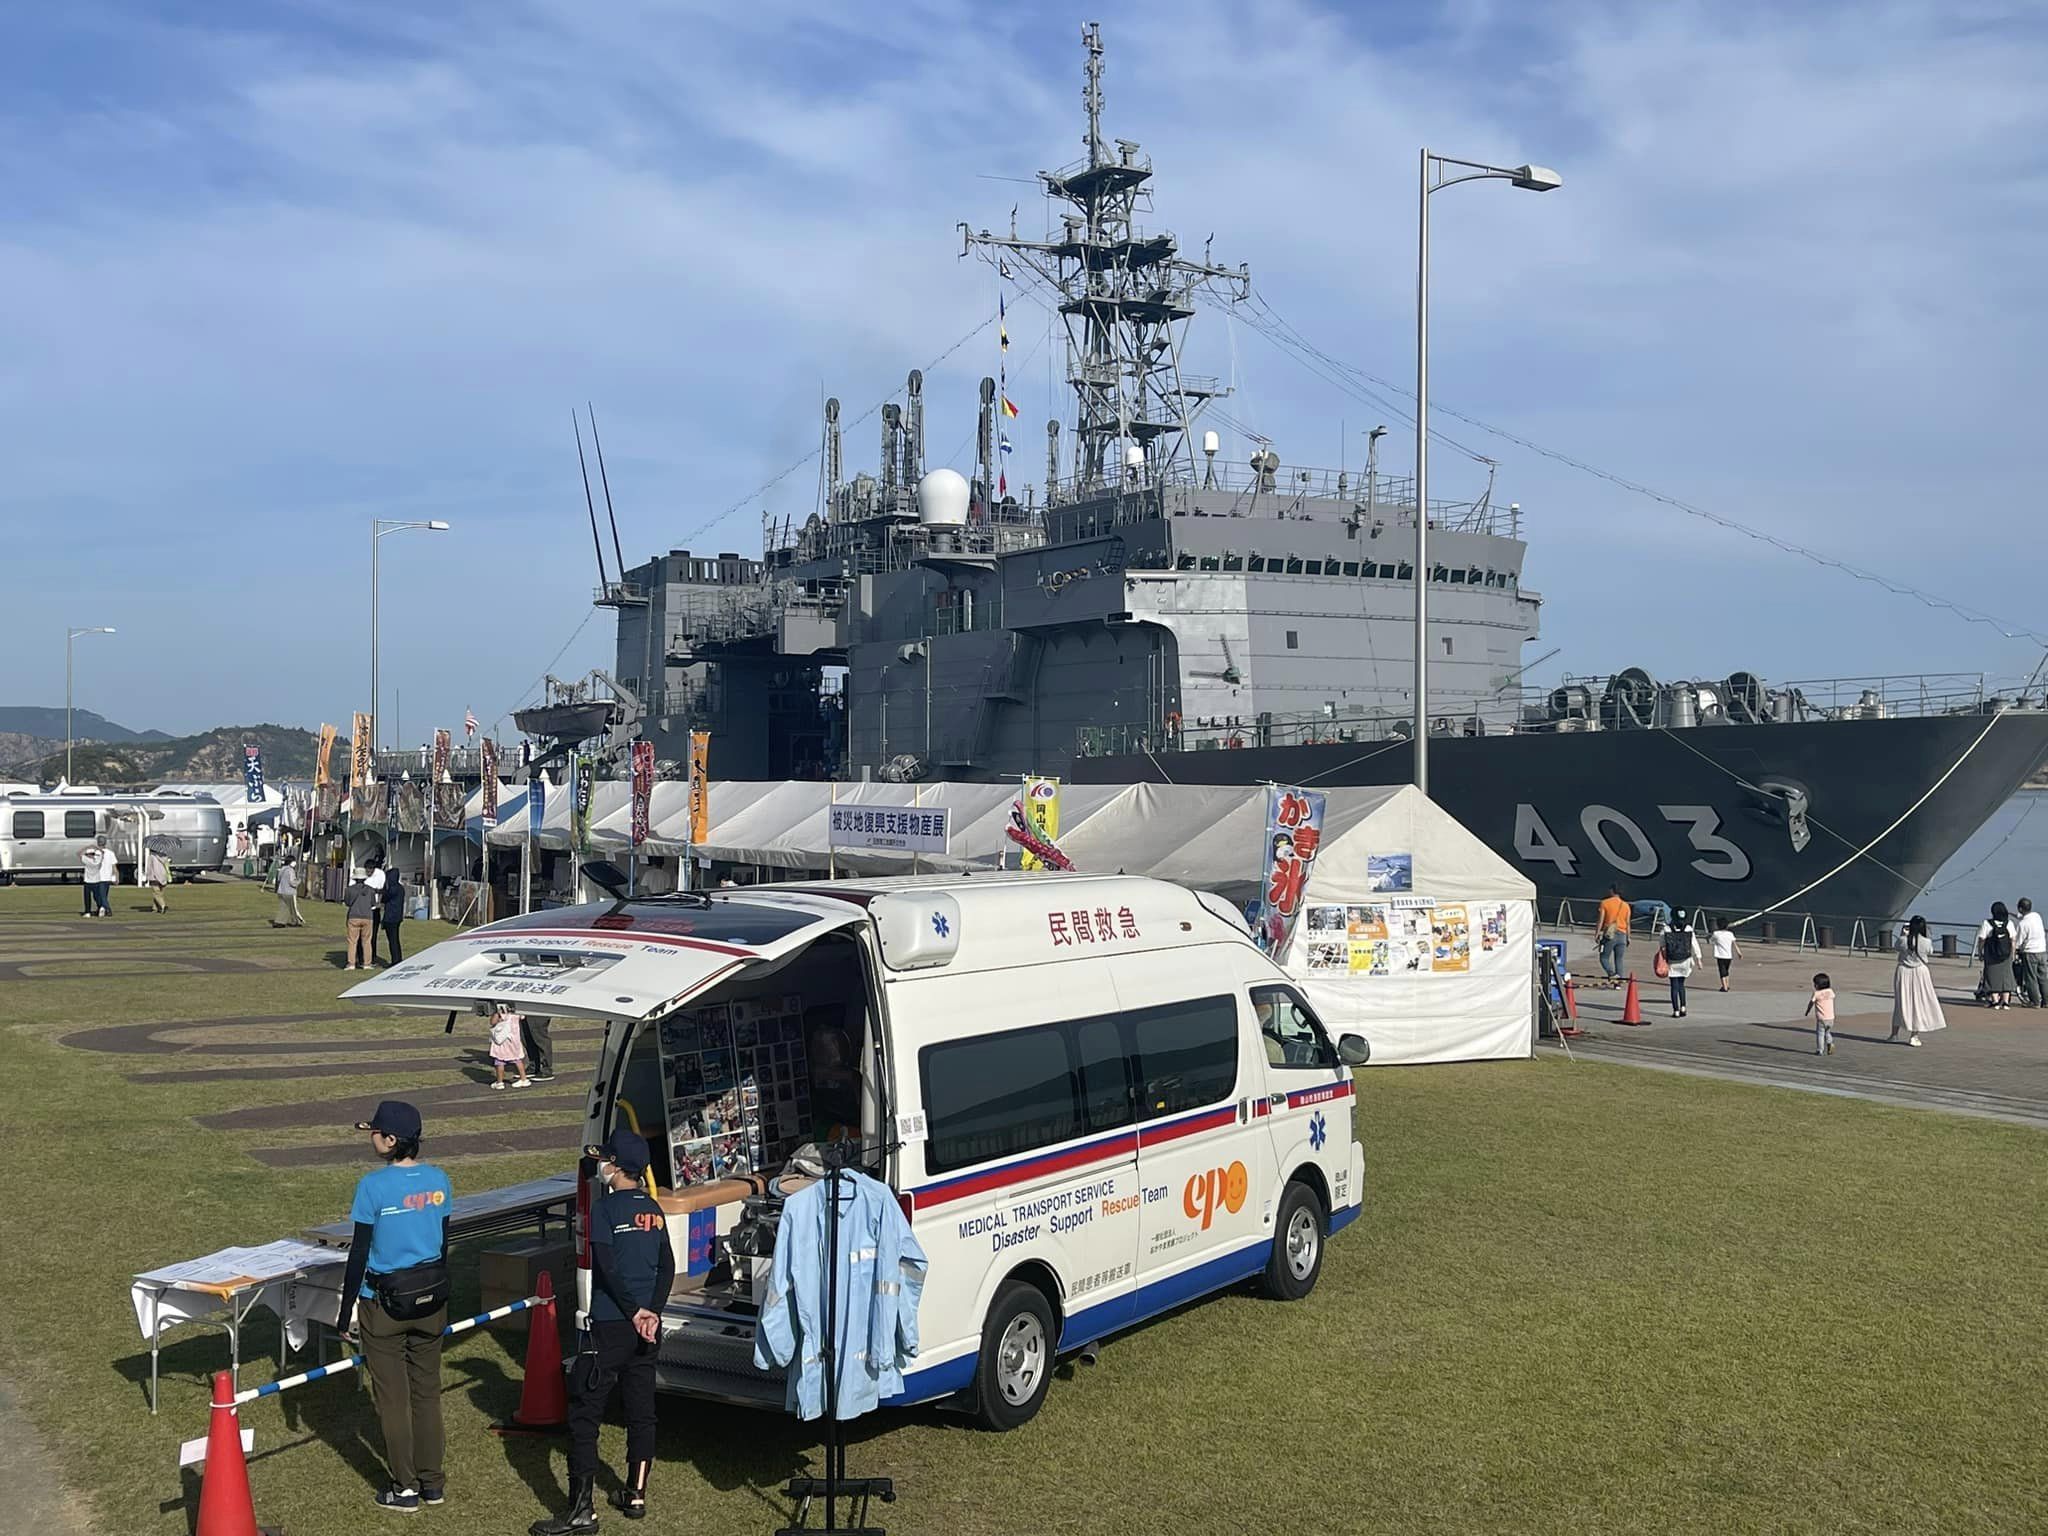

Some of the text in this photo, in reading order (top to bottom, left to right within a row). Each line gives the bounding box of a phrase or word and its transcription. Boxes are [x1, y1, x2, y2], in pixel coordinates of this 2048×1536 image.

[246, 757, 264, 802] 天ぷら
[832, 810, 945, 838] 被災地復興支援物産展
[1513, 803, 1752, 881] 403
[1268, 792, 1322, 916] かき氷
[523, 938, 580, 948] Support
[583, 939, 634, 950] Rescue
[640, 944, 679, 957] Team
[1048, 905, 1141, 947] 民間救急
[959, 1179, 1115, 1239] MEDICAL TRANSPORT SERVICE
[991, 1185, 1169, 1252] Disaster Support Rescue Team
